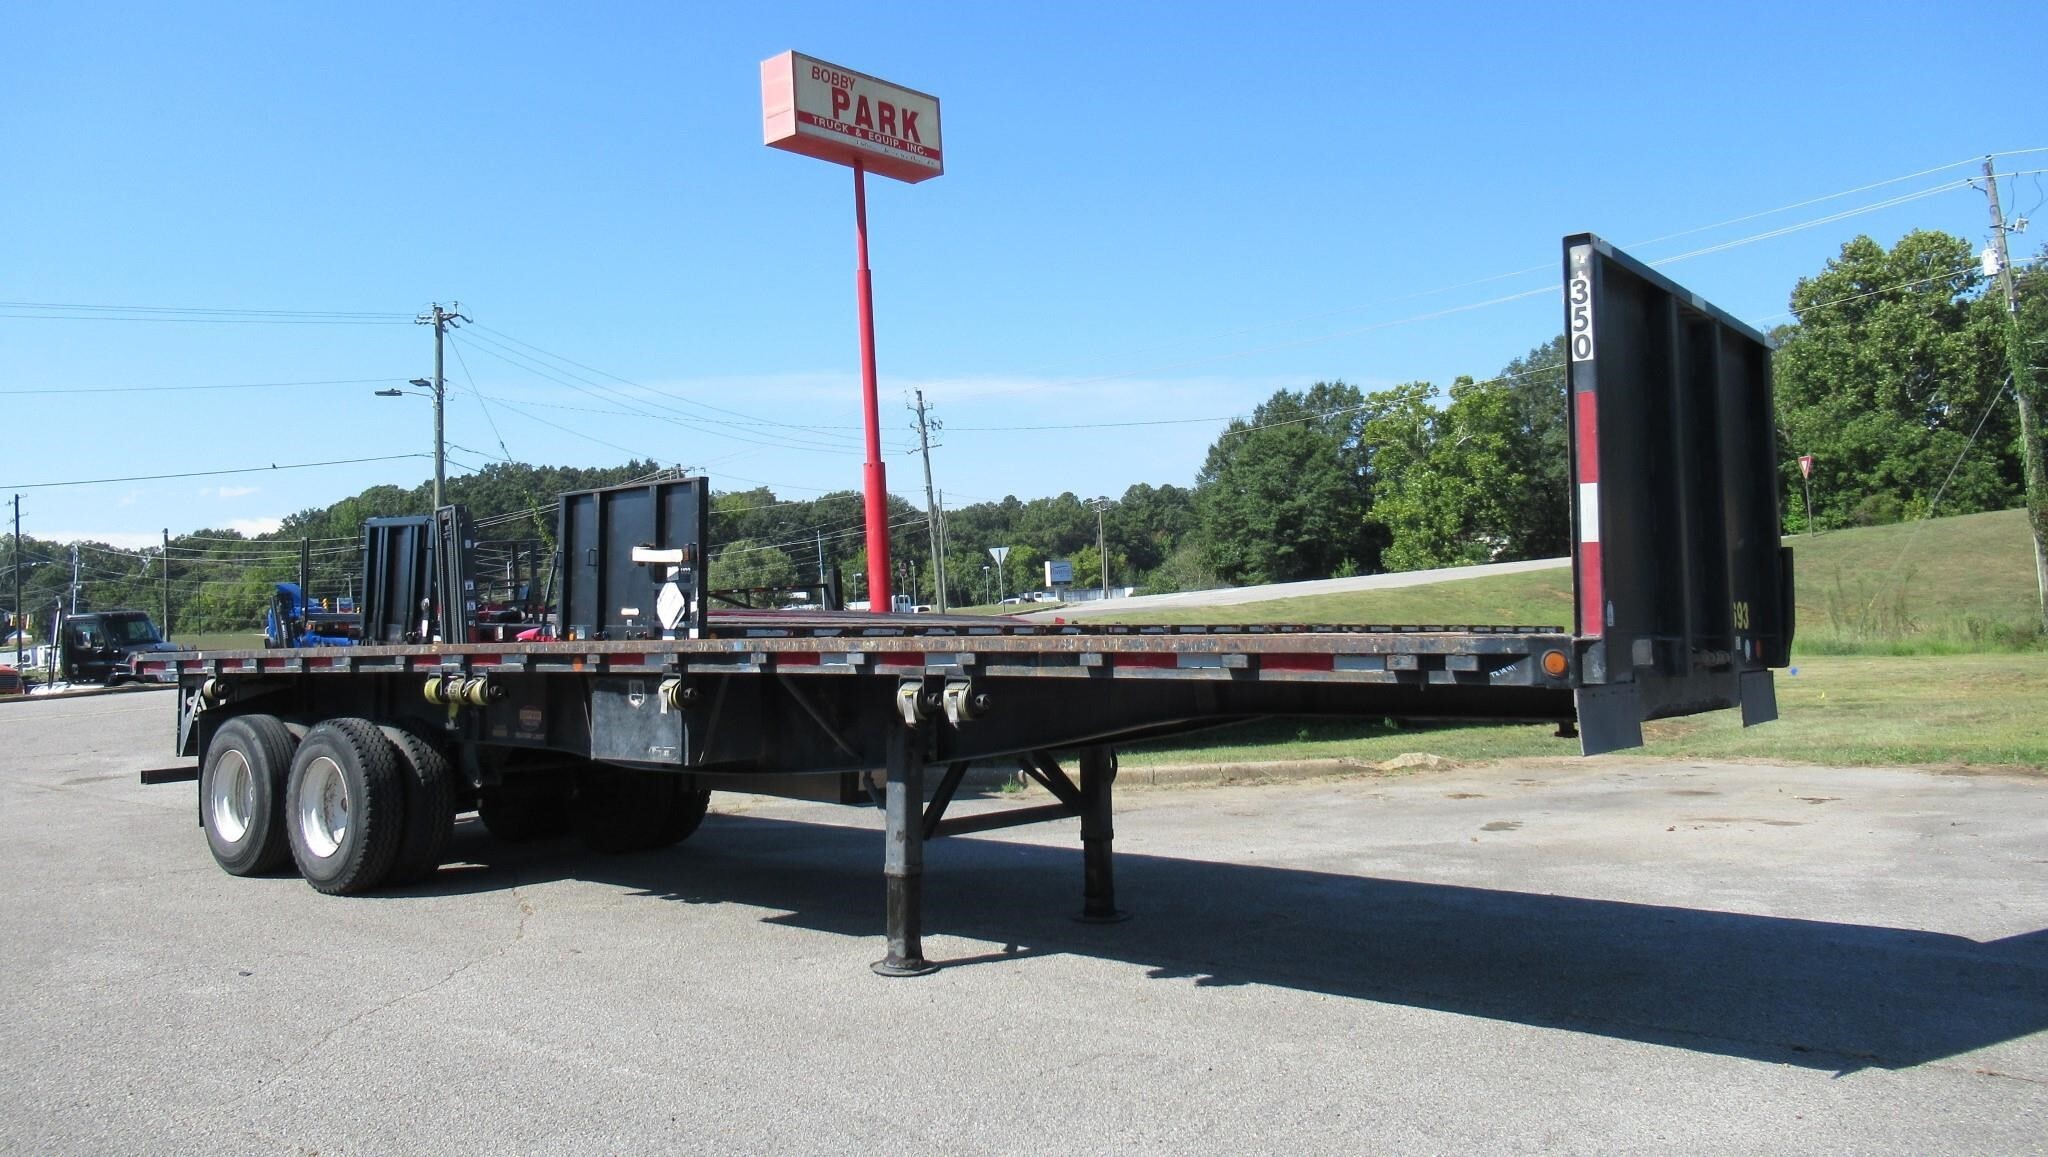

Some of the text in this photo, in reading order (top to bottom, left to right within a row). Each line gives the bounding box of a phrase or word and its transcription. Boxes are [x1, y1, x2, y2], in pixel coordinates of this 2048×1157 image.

[811, 65, 855, 91] BOBBY
[812, 116, 849, 134] TRUCK
[855, 127, 863, 137] &
[868, 131, 901, 149] EQUIP.
[906, 143, 928, 156] INC.
[831, 86, 921, 144] PARK
[1570, 279, 1592, 360] 350
